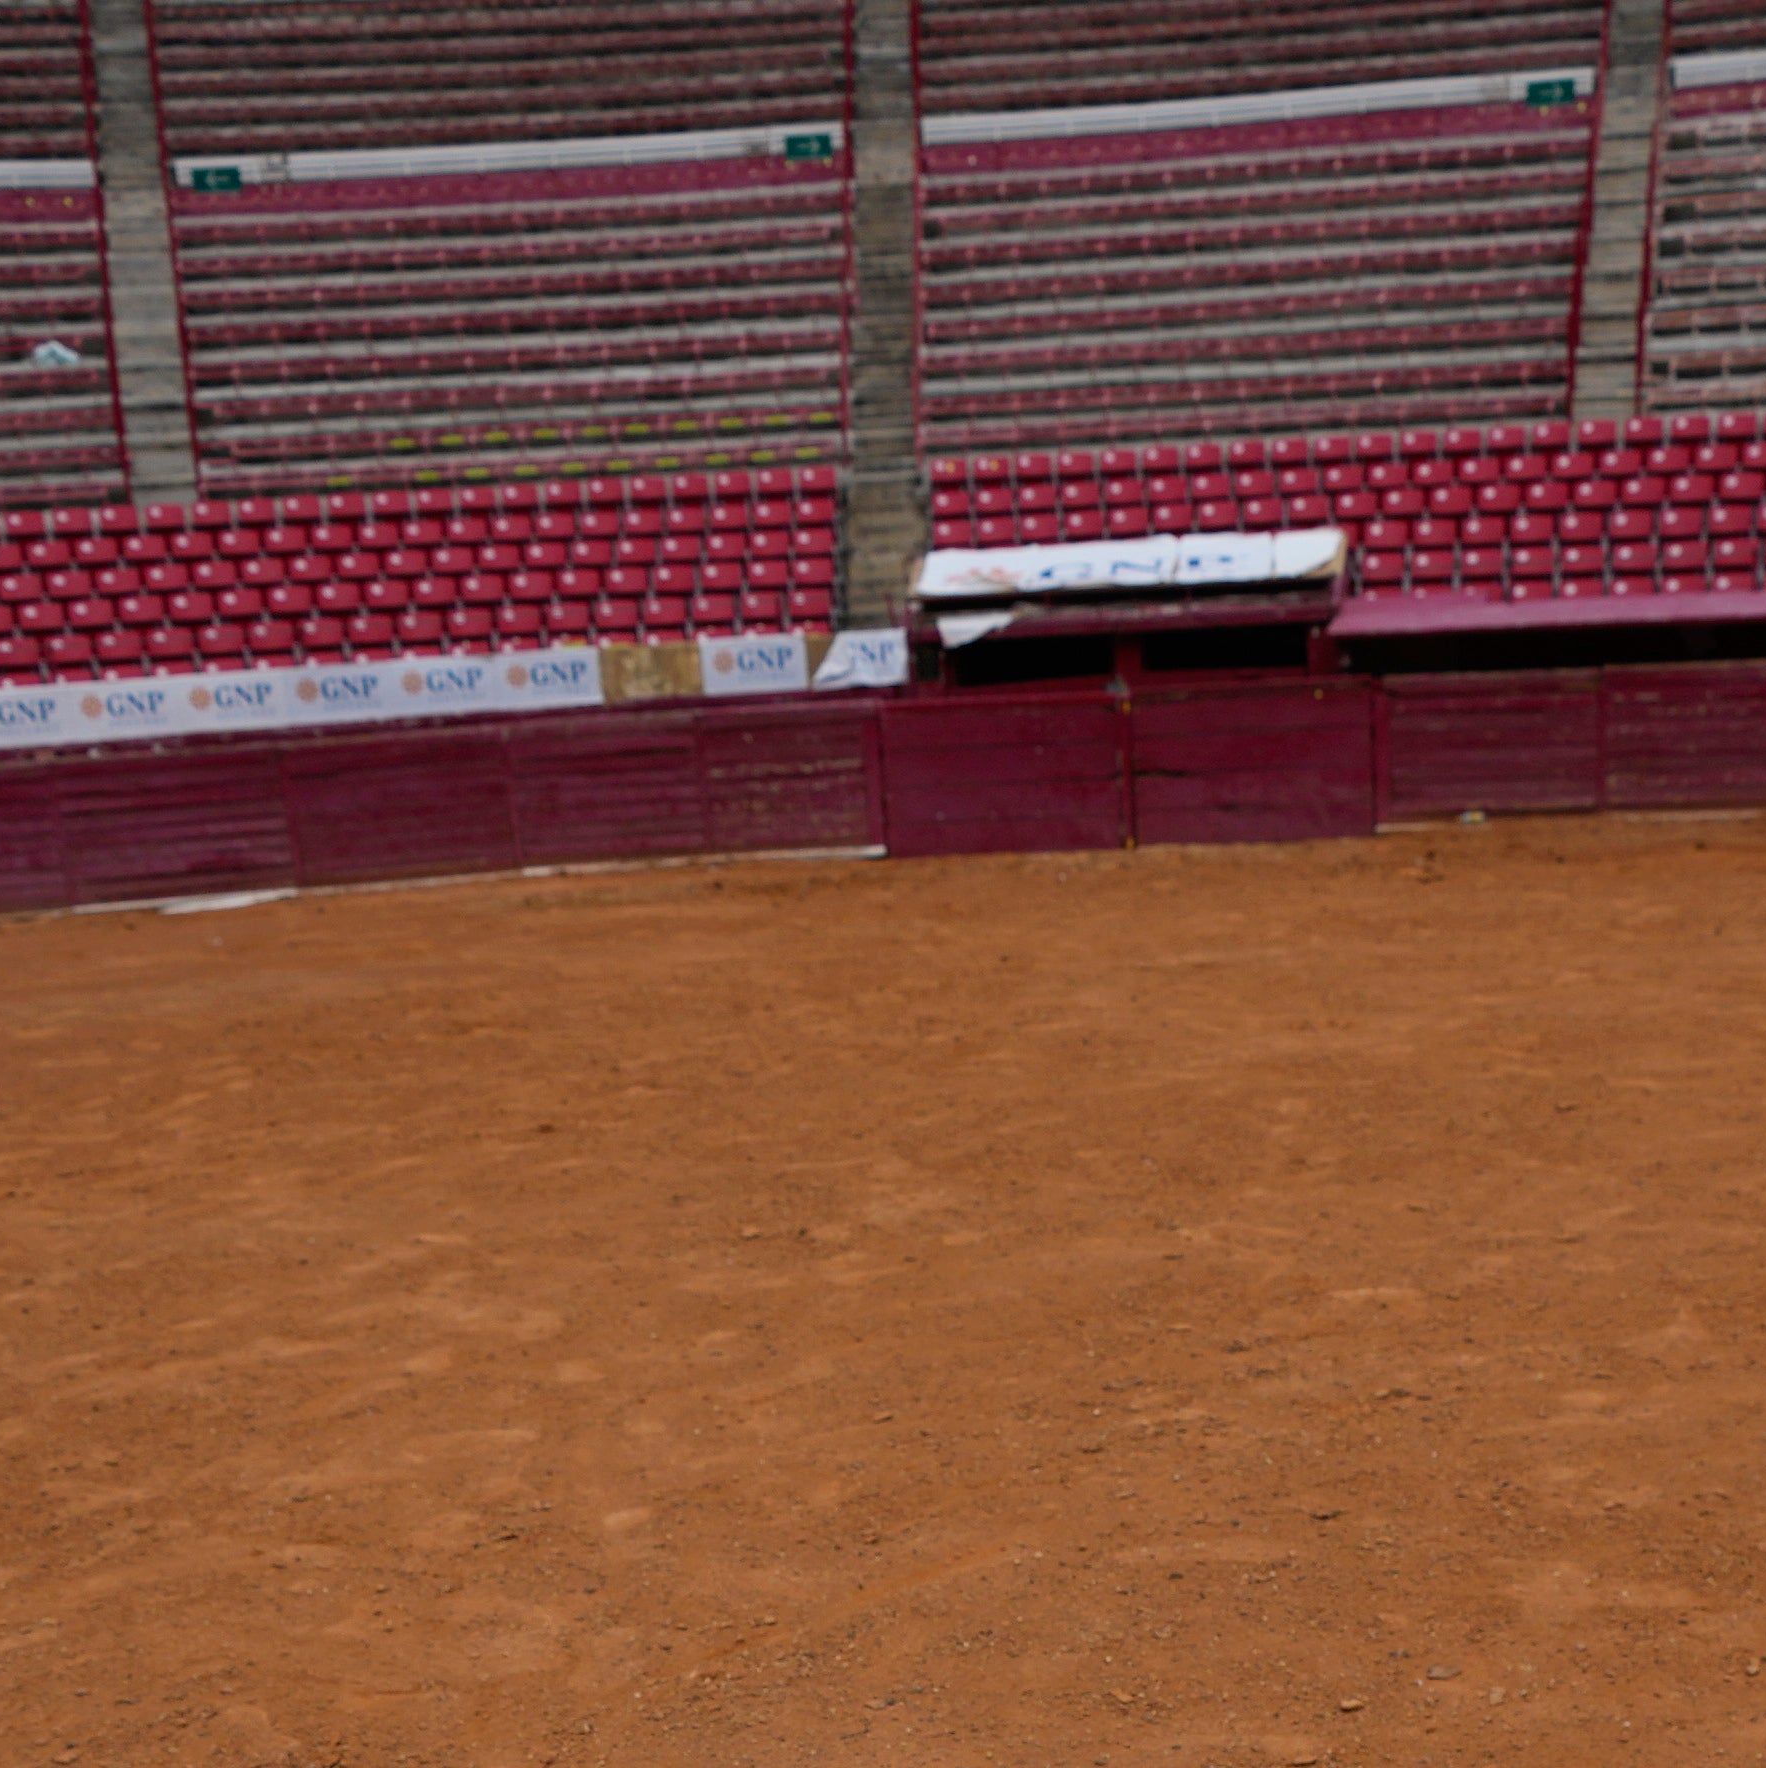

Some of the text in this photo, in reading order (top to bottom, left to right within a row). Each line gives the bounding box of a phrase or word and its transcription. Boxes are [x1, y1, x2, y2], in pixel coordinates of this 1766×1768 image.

[738, 647, 793, 671] GNP
[852, 642, 894, 664] NP
[426, 668, 482, 692] GNP
[530, 661, 587, 685] GNP
[215, 683, 272, 707] GNP
[321, 676, 377, 700] GNP
[106, 691, 164, 716] GNP
